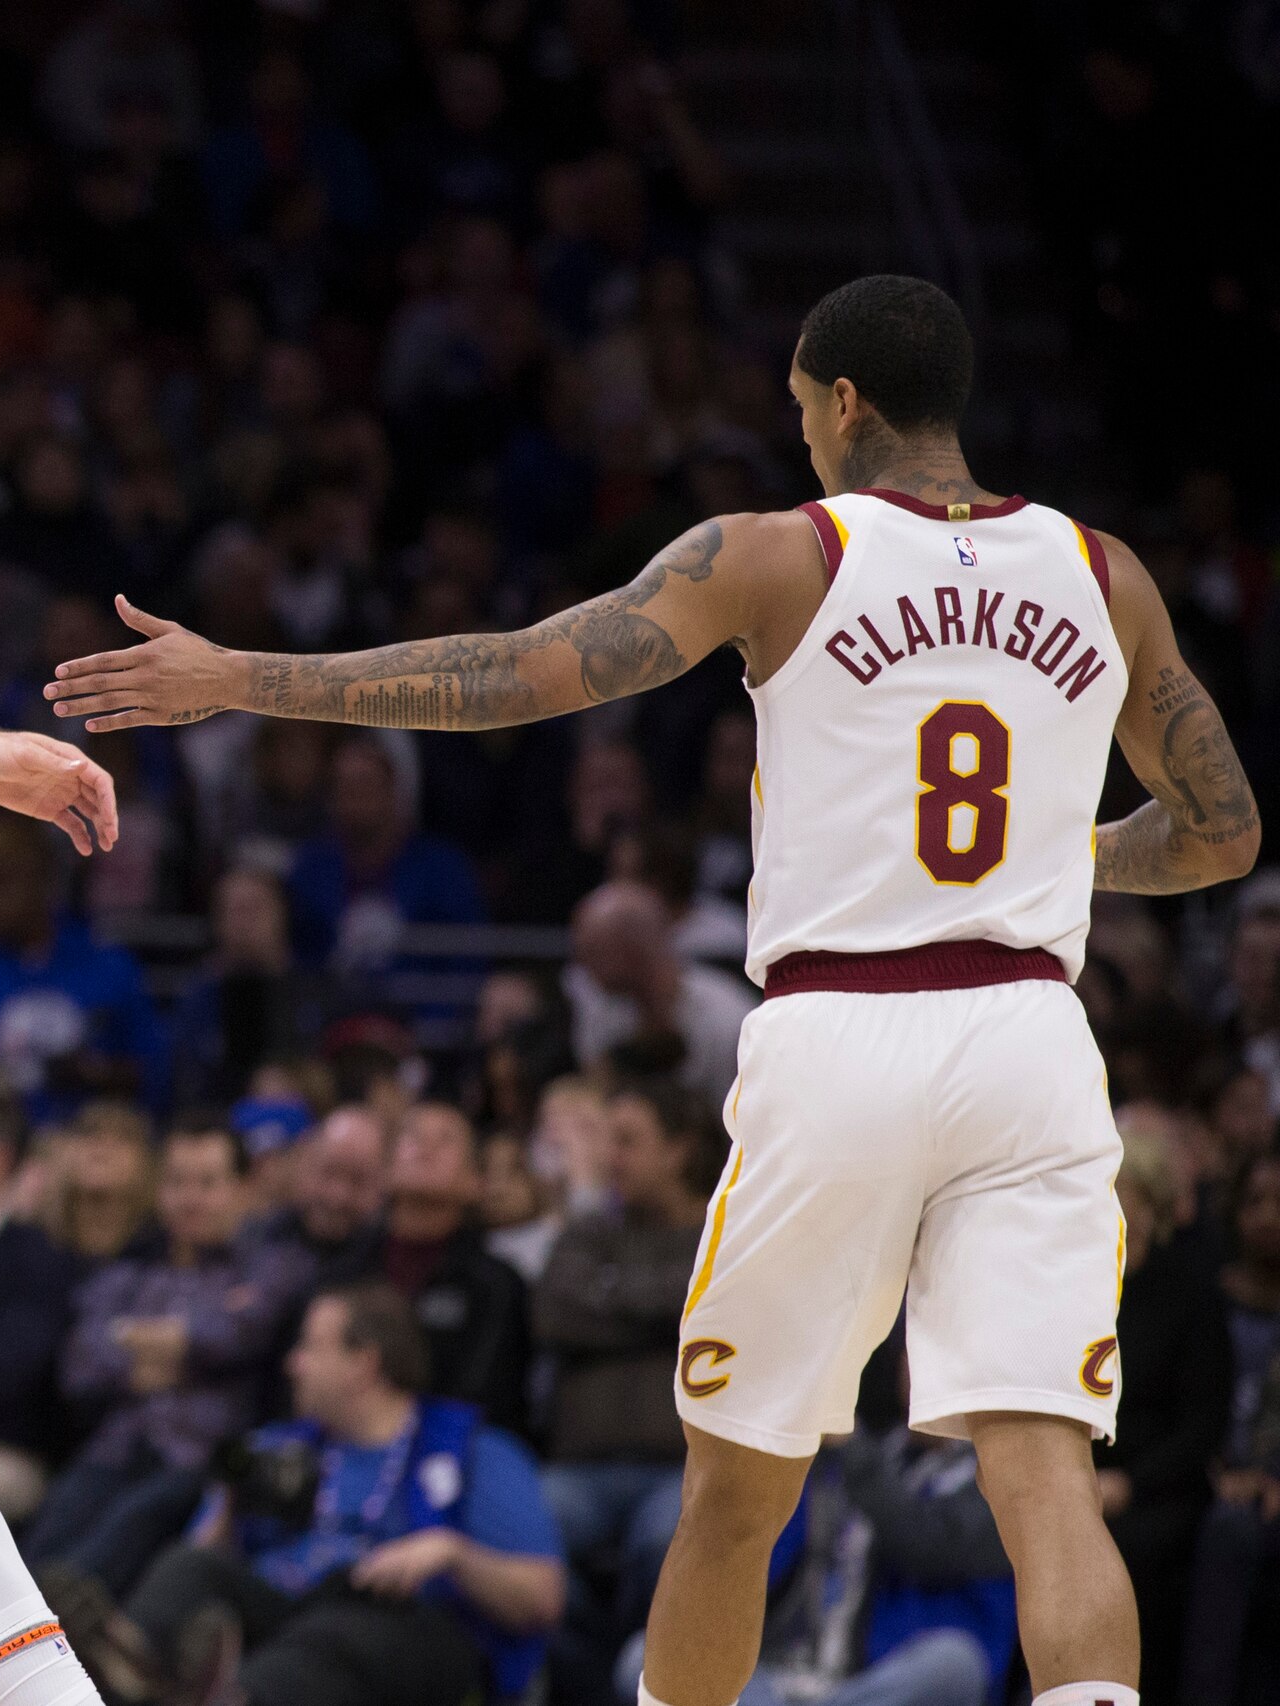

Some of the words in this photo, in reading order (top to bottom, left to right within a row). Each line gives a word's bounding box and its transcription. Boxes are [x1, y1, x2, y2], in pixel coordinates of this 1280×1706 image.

[825, 586, 1107, 703] CLARKSON
[914, 699, 1013, 887] 8
[680, 1338, 736, 1398] C
